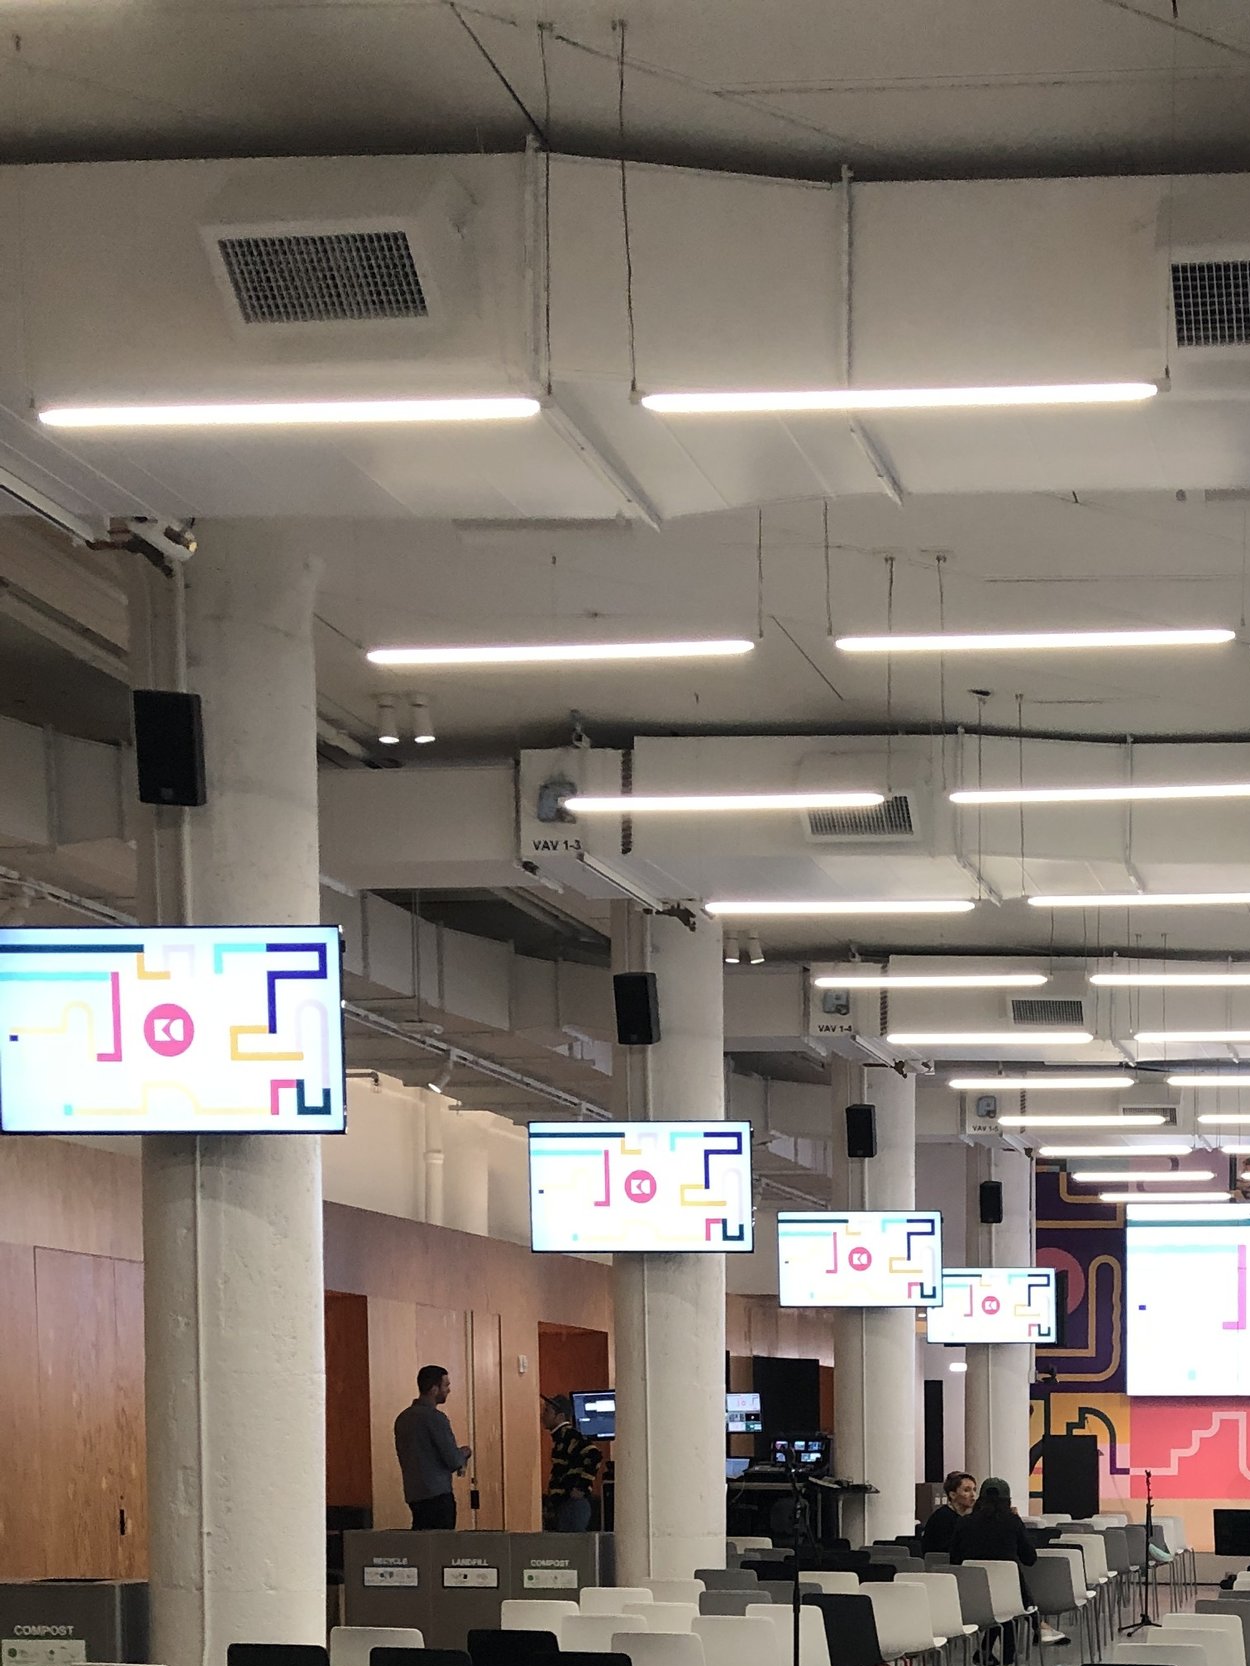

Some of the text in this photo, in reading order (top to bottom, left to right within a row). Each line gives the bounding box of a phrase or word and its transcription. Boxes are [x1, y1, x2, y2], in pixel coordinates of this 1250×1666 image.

[532, 839, 581, 851] VAV 1-3
[817, 1024, 853, 1033] VAV 1-4
[530, 1559, 570, 1567] COMPOST
[13, 1625, 74, 1636] COMPOST
